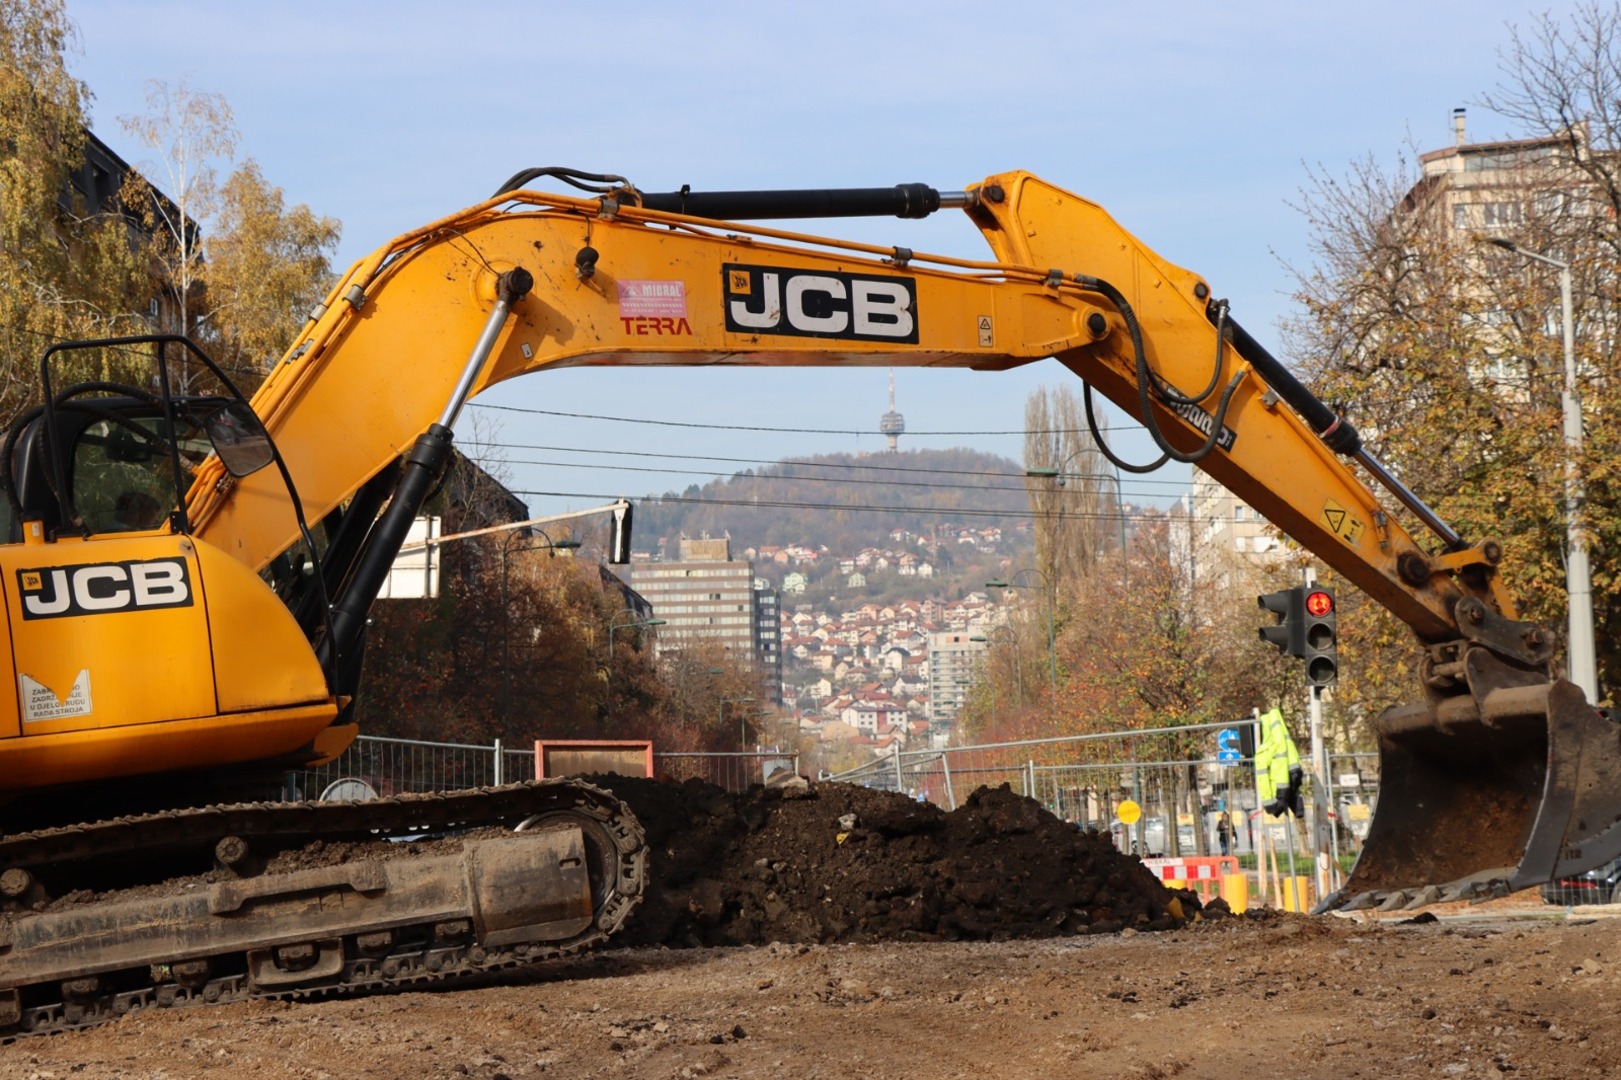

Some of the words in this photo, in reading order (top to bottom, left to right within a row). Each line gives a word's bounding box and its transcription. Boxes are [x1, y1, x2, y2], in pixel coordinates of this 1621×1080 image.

[642, 285, 681, 297] MIBRAL
[730, 272, 914, 337] JCB
[620, 317, 693, 336] TERRA
[24, 561, 188, 615] JCB
[37, 699, 85, 710] DJELORUGU
[33, 710, 54, 718] RADA
[56, 707, 84, 715] STROJA
